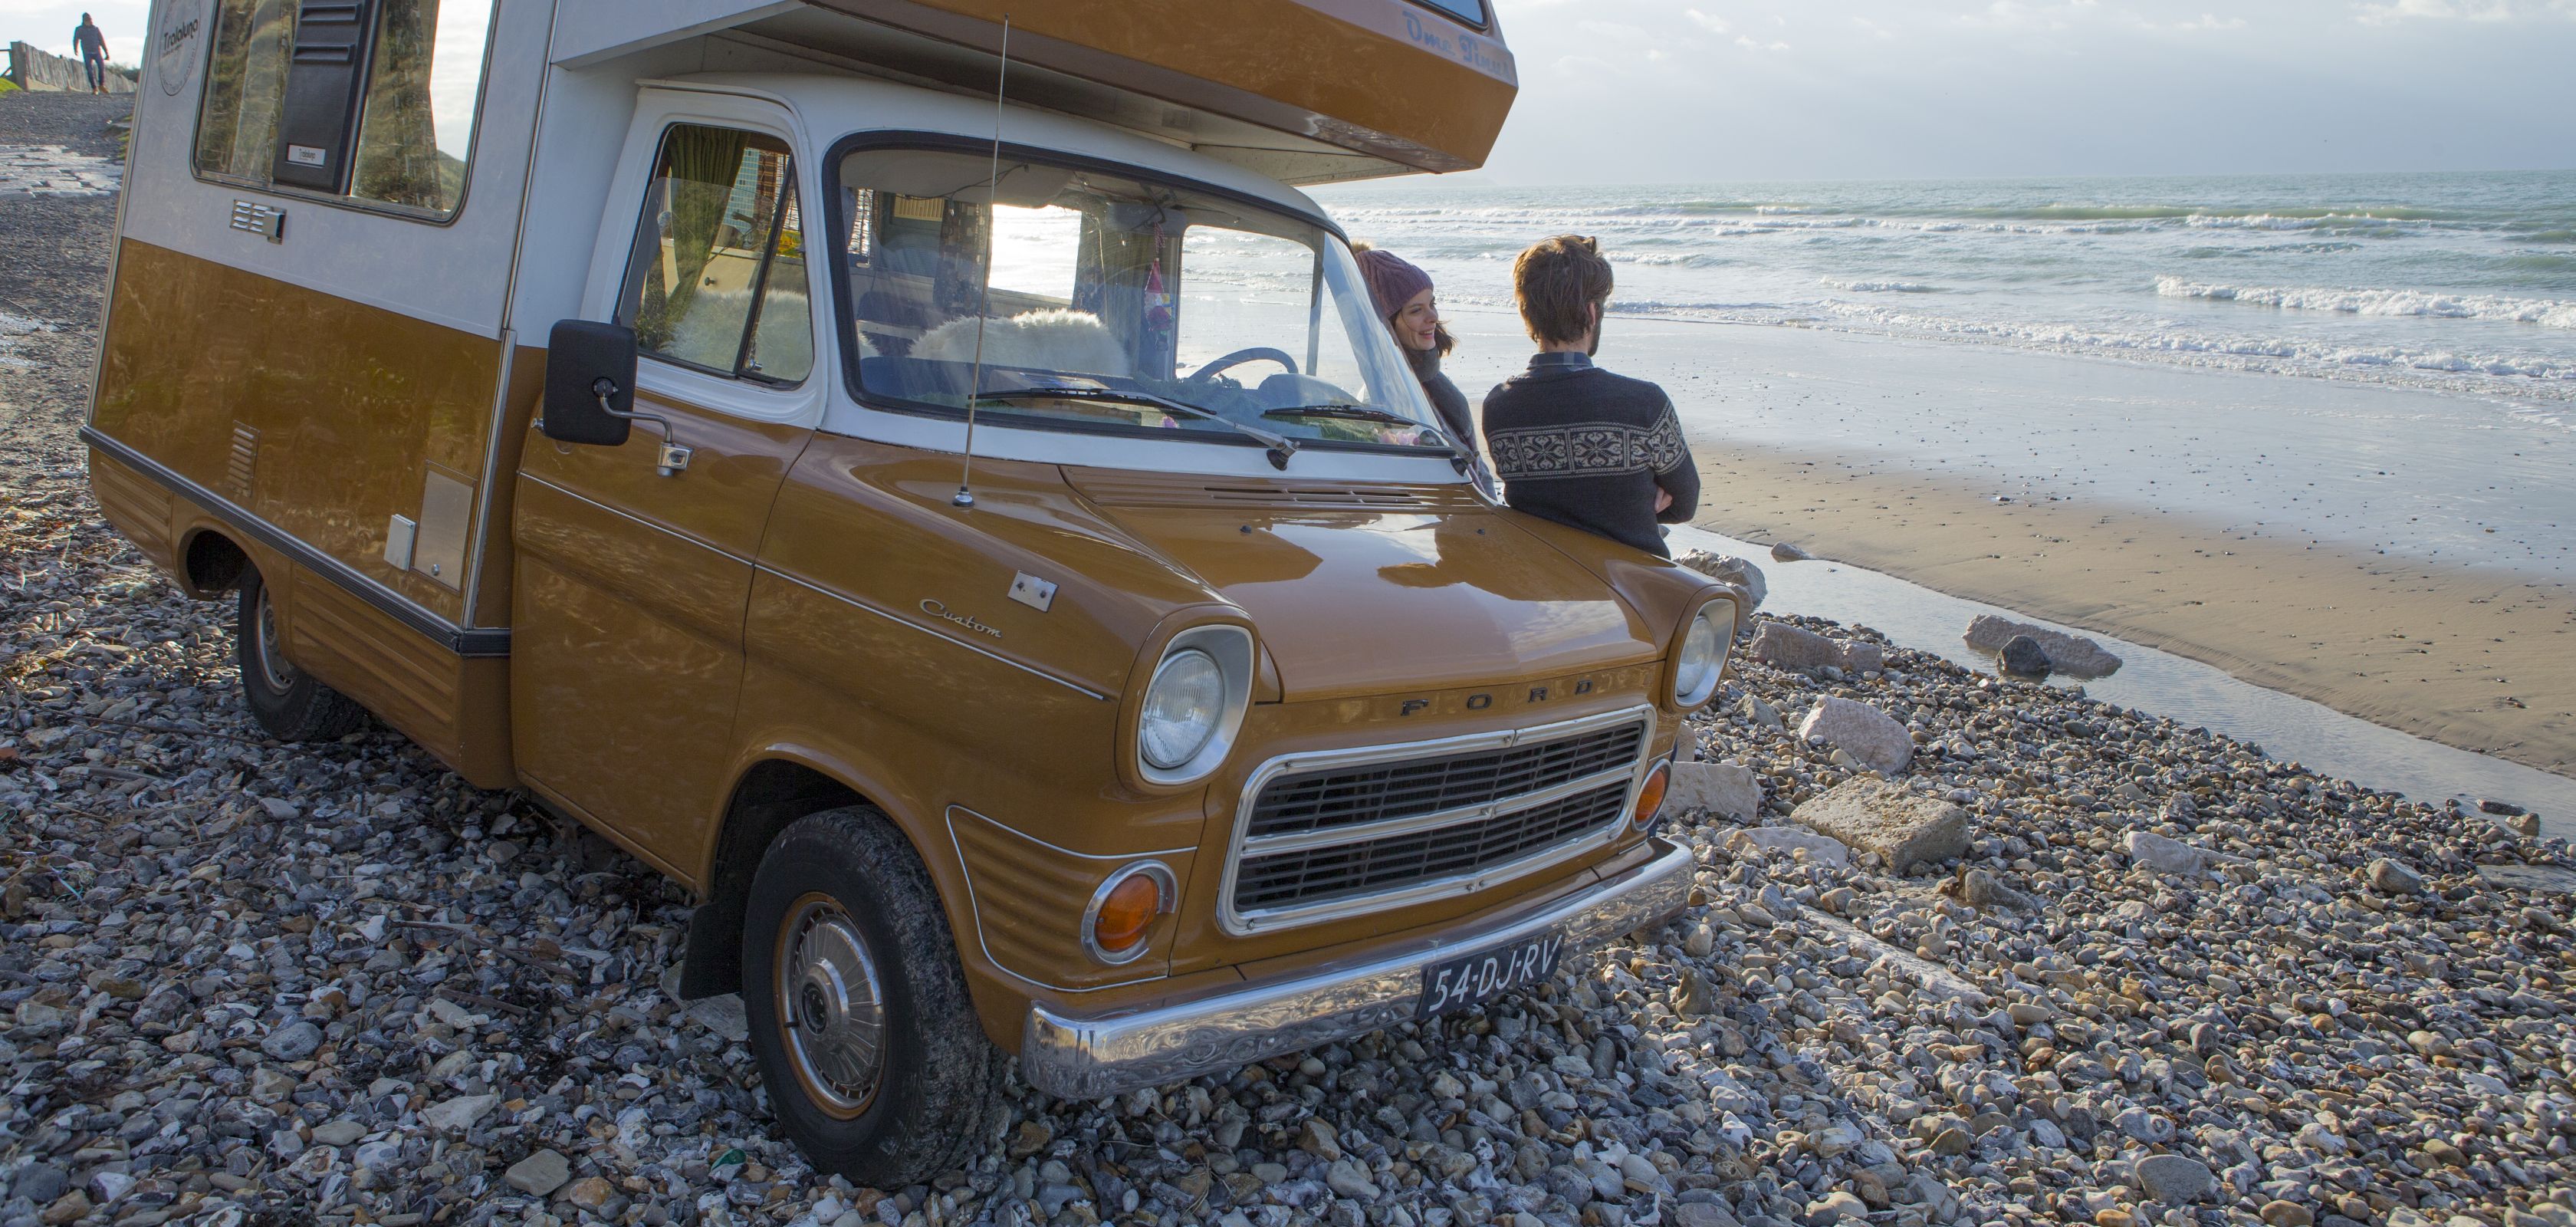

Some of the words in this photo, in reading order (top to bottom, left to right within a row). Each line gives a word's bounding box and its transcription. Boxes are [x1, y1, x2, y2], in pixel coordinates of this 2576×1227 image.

[919, 599, 1003, 638] Custom
[1400, 679, 1593, 716] FORD
[1428, 934, 1563, 1012] 54-DJ-RV
